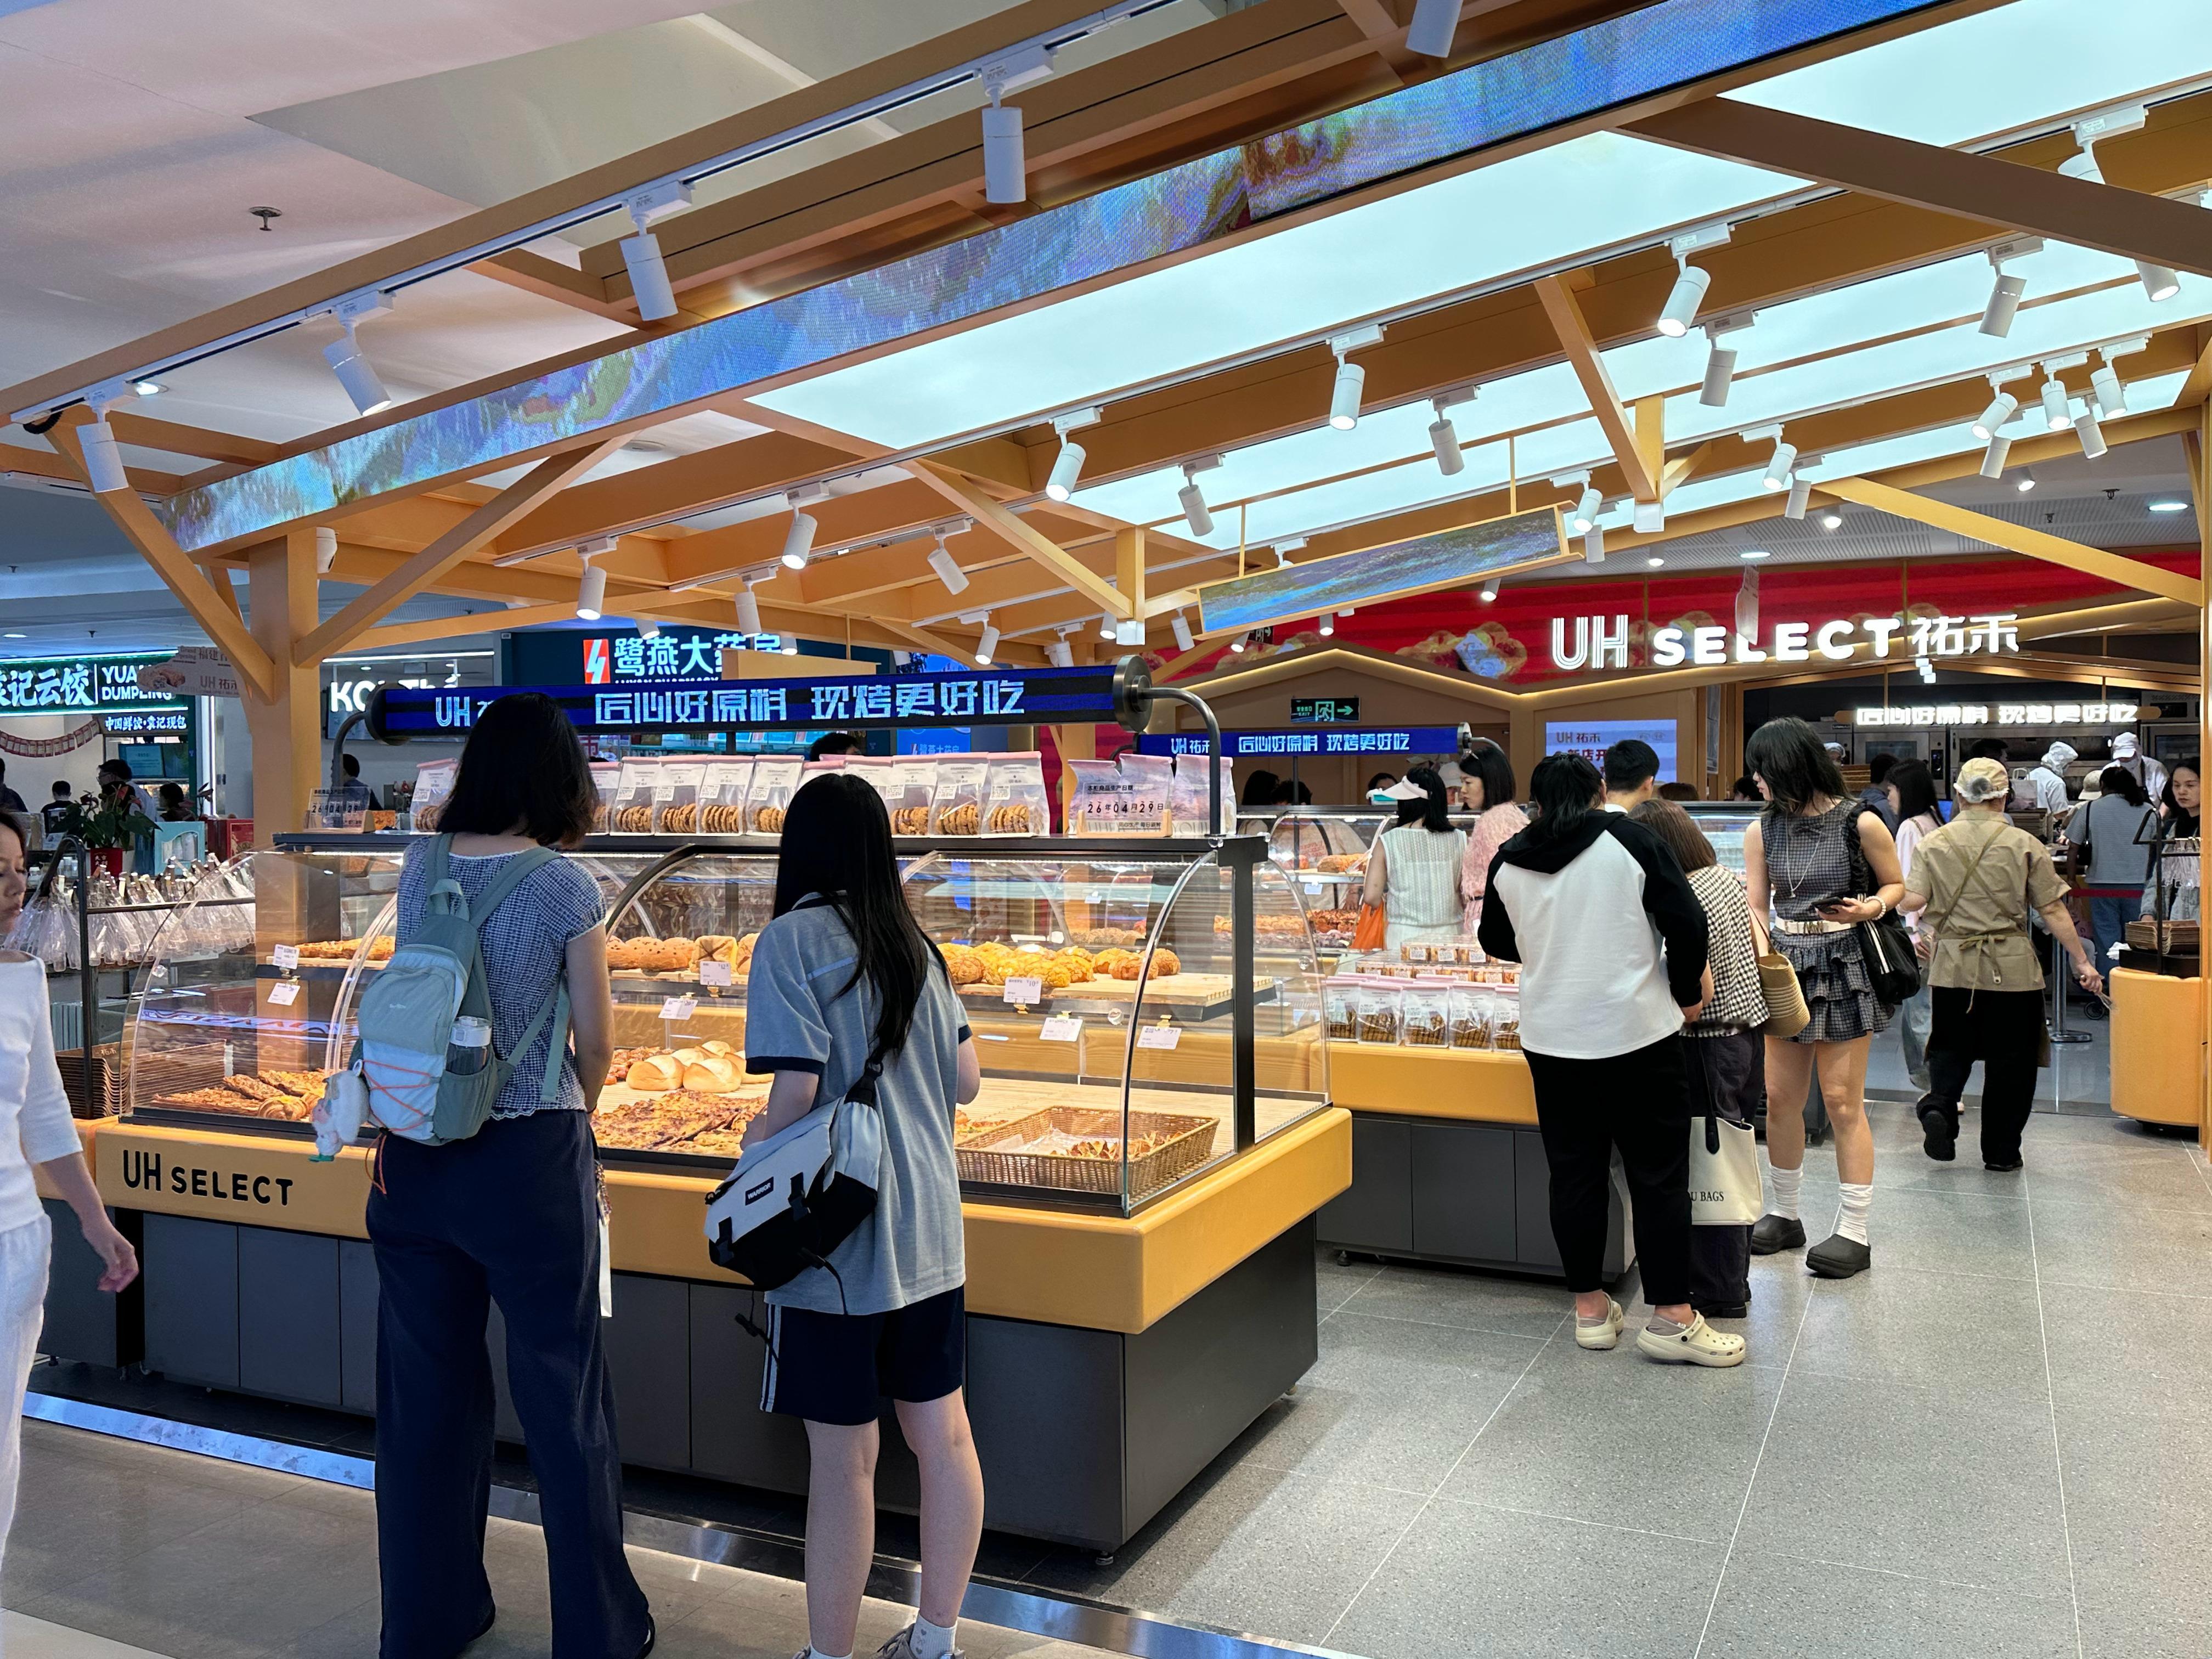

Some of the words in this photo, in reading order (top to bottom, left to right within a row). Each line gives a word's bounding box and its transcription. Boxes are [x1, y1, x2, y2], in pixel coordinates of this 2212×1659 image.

[1553, 614, 1628, 670] UH
[1653, 619, 1901, 667] SELECT
[1910, 613, 2020, 656] 祐禾
[101, 664, 153, 684] YUA
[331, 680, 386, 712] KO
[436, 696, 471, 727] UH
[595, 688, 787, 724] 匠心好原料
[810, 679, 1025, 720] 现烤更好吃
[1171, 737, 1187, 754] UH
[1238, 734, 1318, 753] 匠心好原料
[1327, 732, 1410, 752] 现烤更好吃
[1556, 732, 1573, 743] UH
[123, 1149, 161, 1192] UH
[171, 1166, 294, 1206] SELECT
[747, 1182, 771, 1200] WARRIOR
[1700, 1190, 1724, 1202] BAGS
